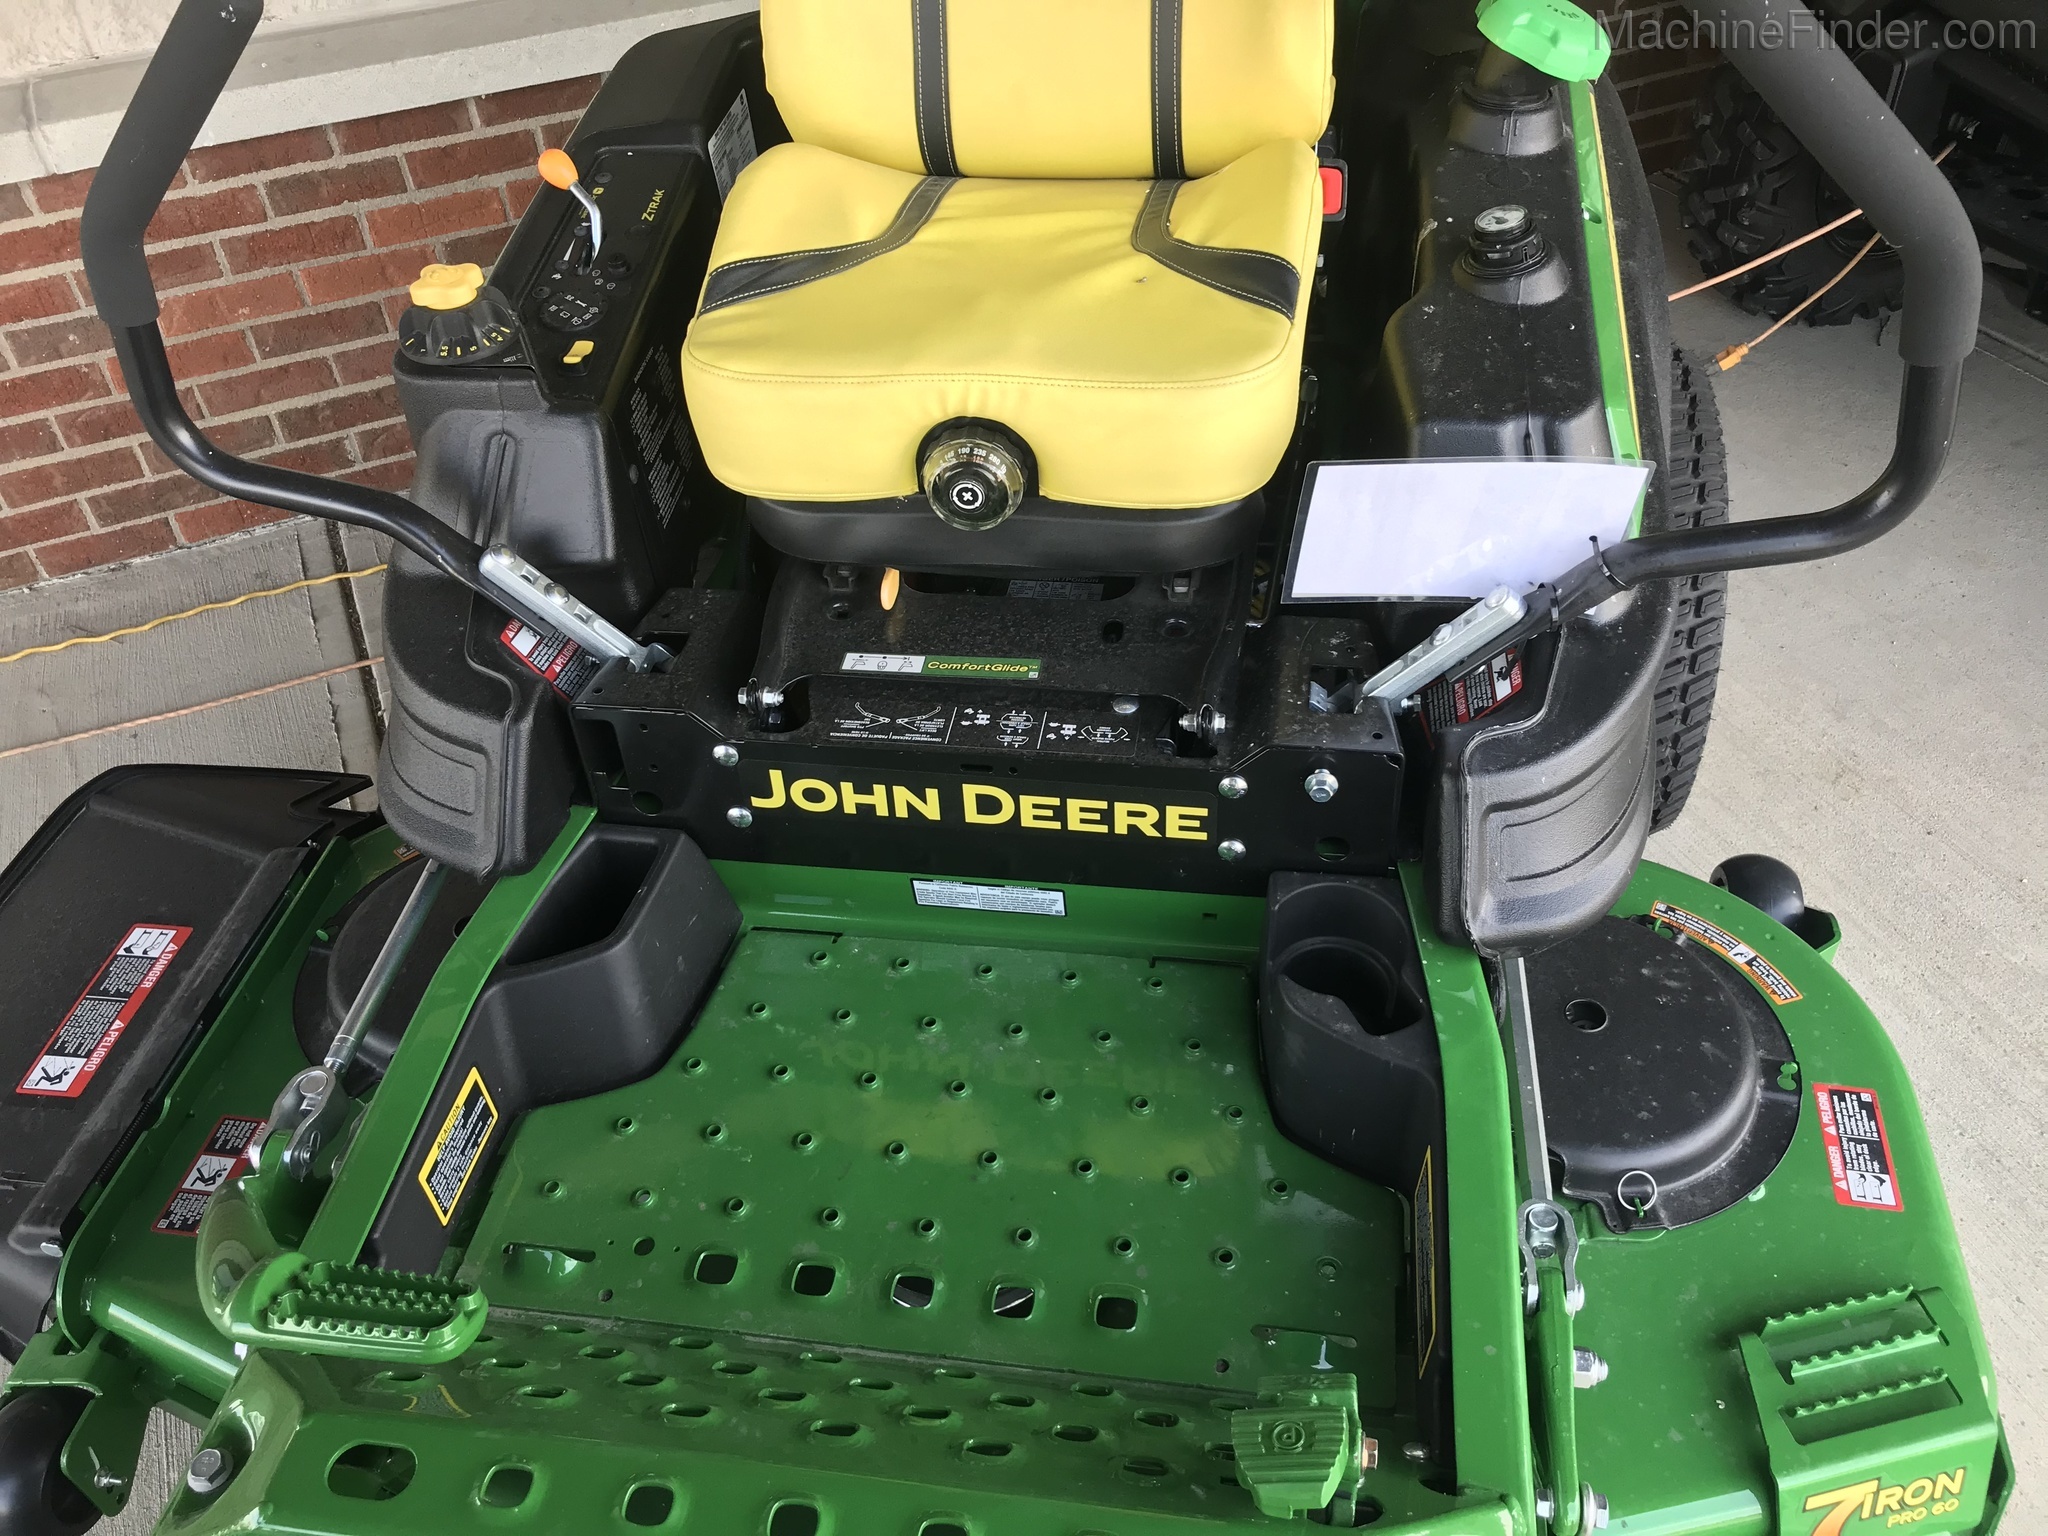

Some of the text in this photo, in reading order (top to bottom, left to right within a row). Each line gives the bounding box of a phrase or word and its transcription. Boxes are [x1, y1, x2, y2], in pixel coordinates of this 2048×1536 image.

[641, 189, 665, 222] ZTRAK
[440, 345, 449, 357] 5.5
[957, 446, 971, 454] 190
[973, 447, 987, 457] 235
[556, 641, 578, 668] PELIGRO
[1455, 686, 1466, 716] PELIGRO
[750, 768, 1209, 841] JOHN DEERE
[140, 953, 173, 989] DANGER
[83, 1030, 119, 1072] PELIGRO
[440, 1104, 460, 1142] CAUTION
[1817, 1091, 1833, 1124] PELIGRO
[1828, 1145, 1844, 1178] DANGER
[1886, 1497, 1960, 1529] PRO 60
